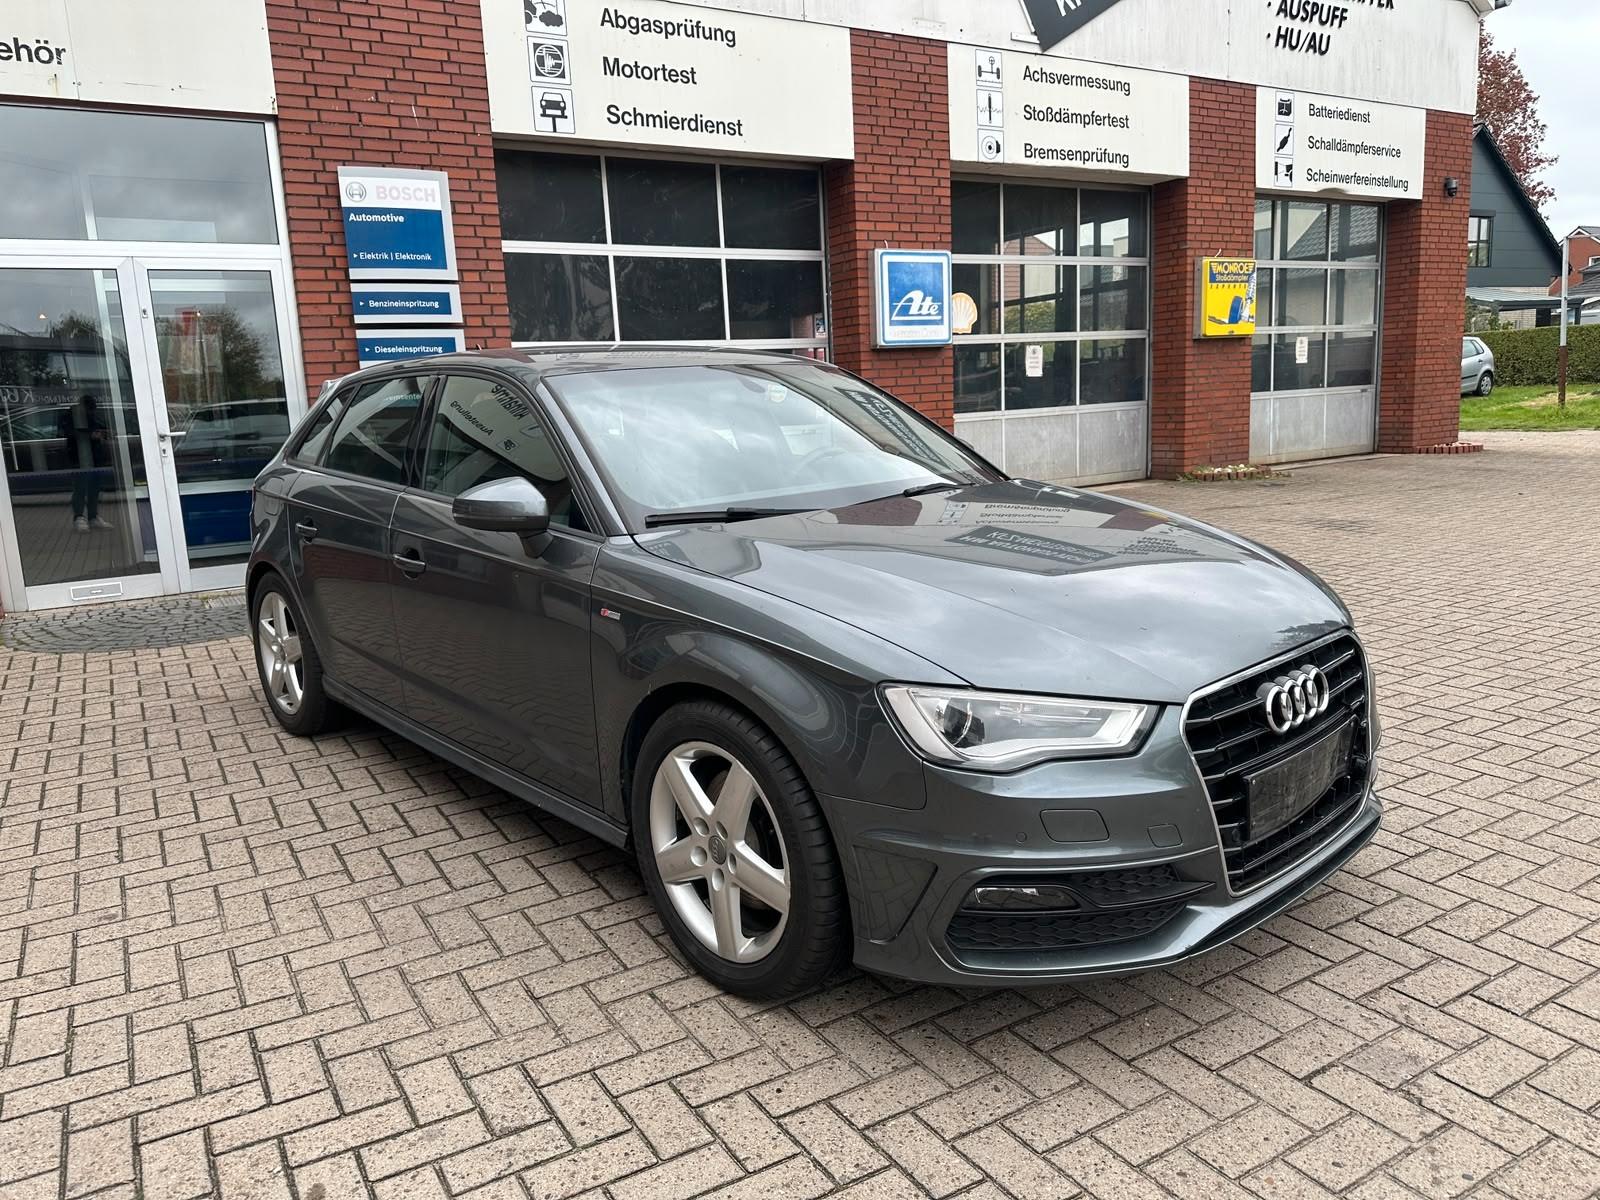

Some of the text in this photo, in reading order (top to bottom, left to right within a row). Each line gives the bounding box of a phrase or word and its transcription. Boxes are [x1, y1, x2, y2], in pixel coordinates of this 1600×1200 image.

[1276, 0, 1348, 29] AUSPUFF
[600, 8, 736, 47] Abgasprüfung
[1275, 25, 1331, 56] HU/AU
[602, 56, 697, 85] Motortest
[1023, 65, 1131, 96] Achsvermessung
[606, 104, 743, 137] Schmierdienst
[1023, 104, 1130, 129] Stoßdämpfertest
[1308, 103, 1371, 124] Batteriedienst
[1023, 142, 1130, 168] Bremsenprüfung
[1307, 135, 1401, 159] Schalldämpferservice
[1306, 167, 1409, 192] Scheinwerfereinstellung
[375, 185, 436, 203] BOSCH
[349, 212, 405, 223] Automotive
[359, 251, 389, 260] Elektrik
[395, 252, 432, 261] Elektronik
[1215, 262, 1250, 274] MONROE
[368, 299, 440, 309] Benzineinspritzung
[374, 344, 443, 354] Dieseleinspritzung
